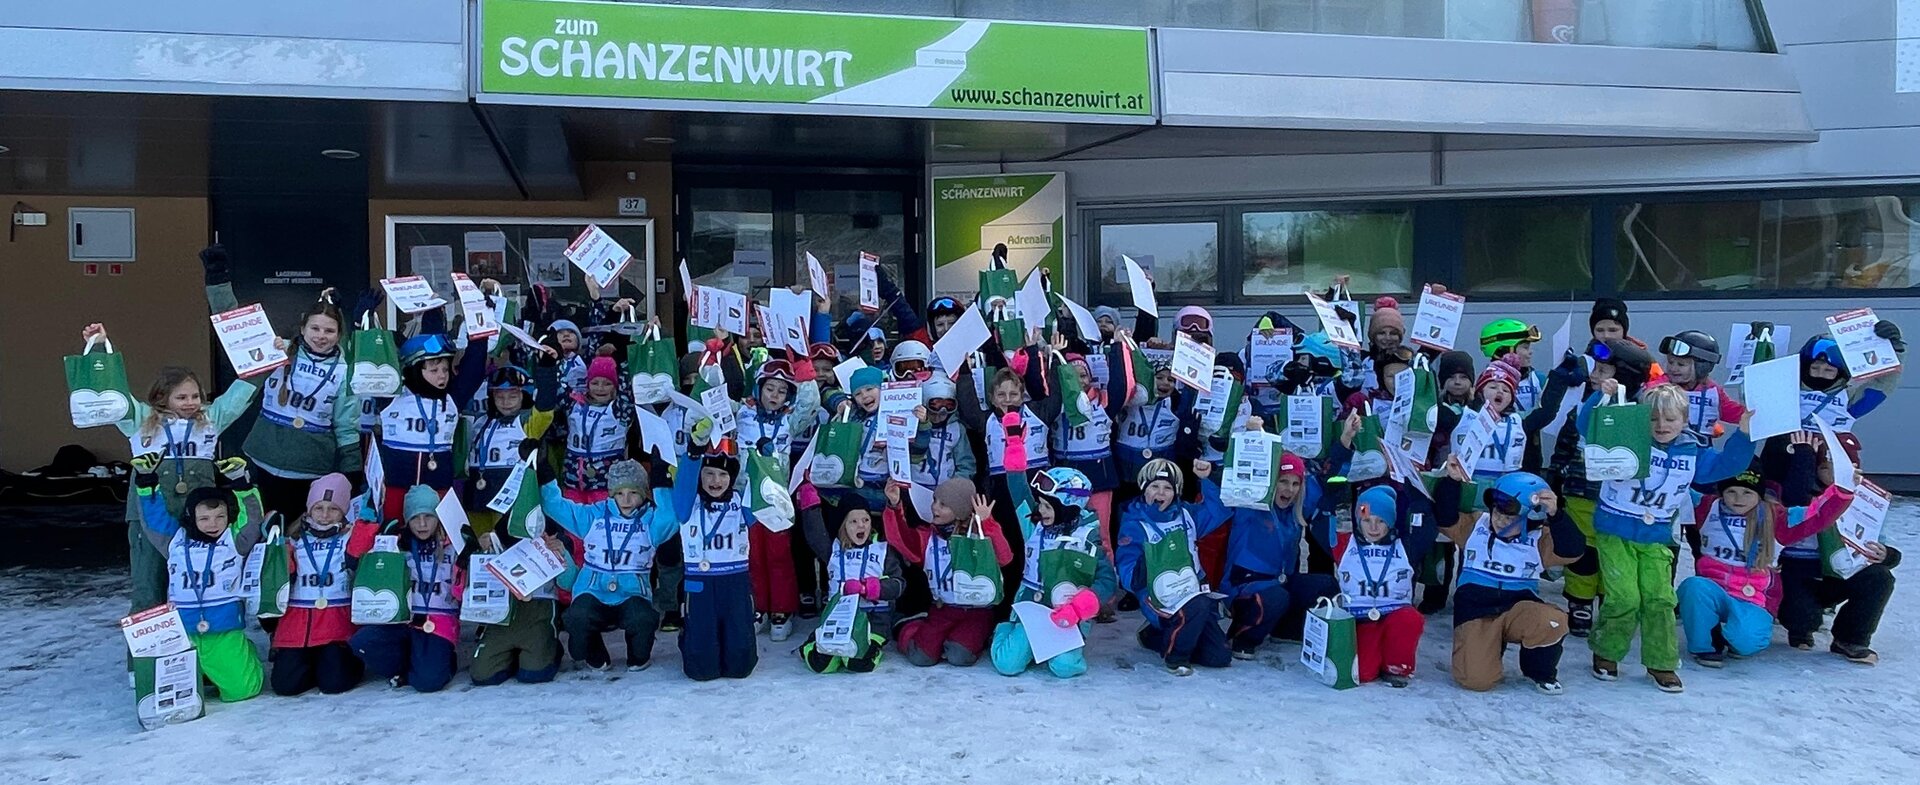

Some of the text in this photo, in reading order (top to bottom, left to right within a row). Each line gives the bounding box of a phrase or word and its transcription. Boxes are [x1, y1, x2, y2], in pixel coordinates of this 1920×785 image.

[554, 18, 599, 36] zum
[500, 37, 852, 87] SCHANZENWIRT
[951, 88, 1144, 110] www.schanzenwirt.at
[941, 186, 1025, 200] SCHANZENWIRT
[625, 199, 639, 210] 37
[1007, 234, 1051, 245] Adrenalin
[1424, 298, 1459, 314] URKUNDE
[221, 317, 262, 335] URKUNDE
[884, 391, 918, 402] URKUNDE
[132, 617, 176, 640] URKUNDE
